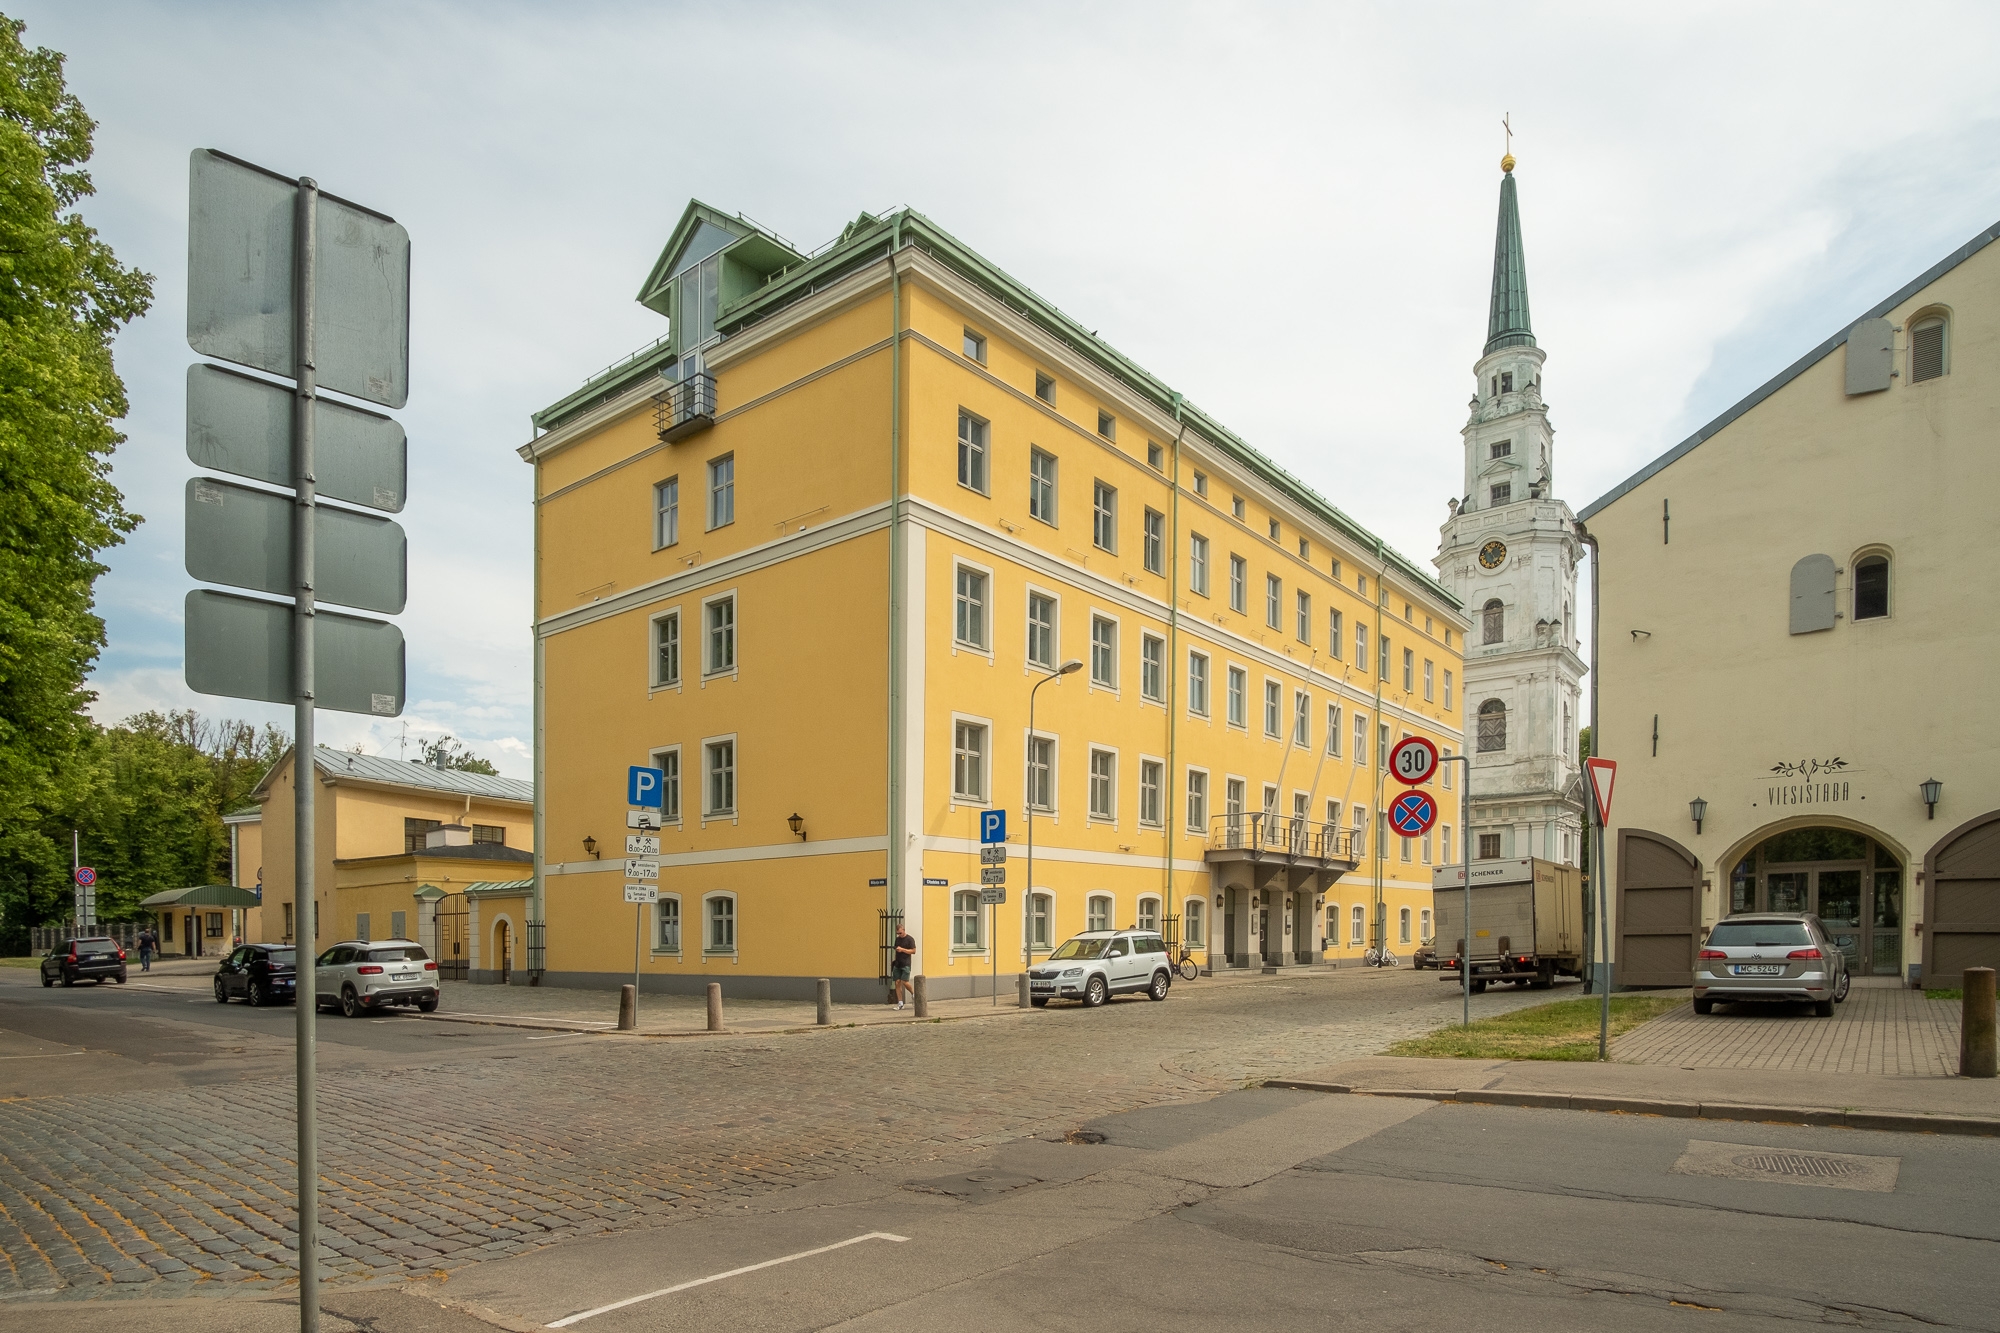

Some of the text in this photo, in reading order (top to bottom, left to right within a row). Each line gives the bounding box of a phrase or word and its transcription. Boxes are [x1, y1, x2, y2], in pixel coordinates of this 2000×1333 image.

[1402, 749, 1425, 773] 30
[636, 771, 655, 801] P
[1768, 782, 1849, 806] VIESISTABA
[986, 814, 1000, 839] P
